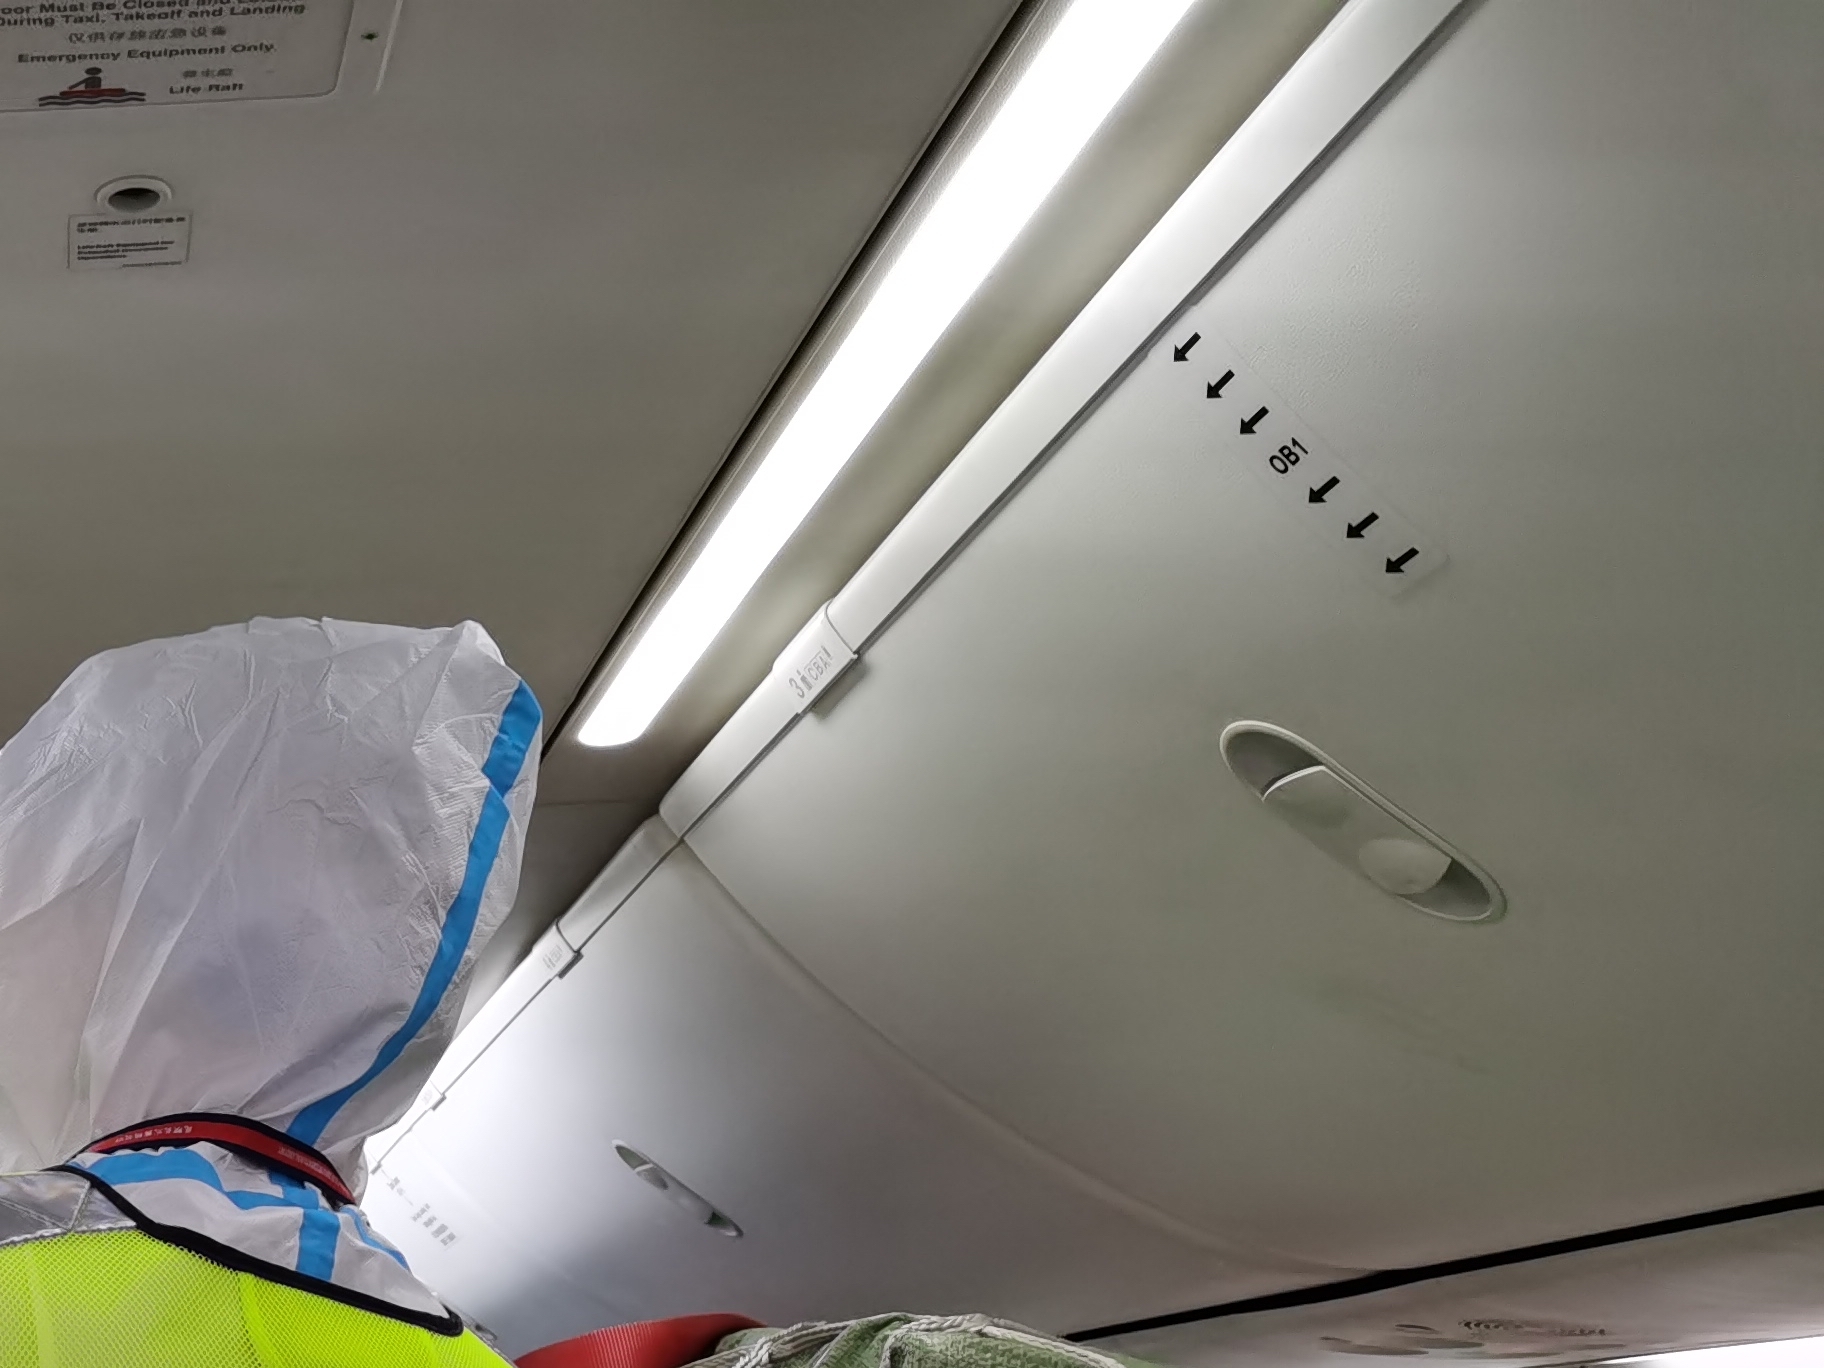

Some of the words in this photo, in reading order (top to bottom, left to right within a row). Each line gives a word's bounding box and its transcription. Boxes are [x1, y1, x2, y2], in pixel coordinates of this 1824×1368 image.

[39, 2, 85, 13] Must
[91, 1, 117, 11] Be
[111, 8, 184, 21] Takeoff
[187, 6, 224, 18] and
[229, 3, 306, 16] Landing
[17, 51, 121, 64] Emergency
[126, 44, 226, 60] Equipment
[169, 85, 202, 95] Life
[208, 82, 244, 92] Raft
